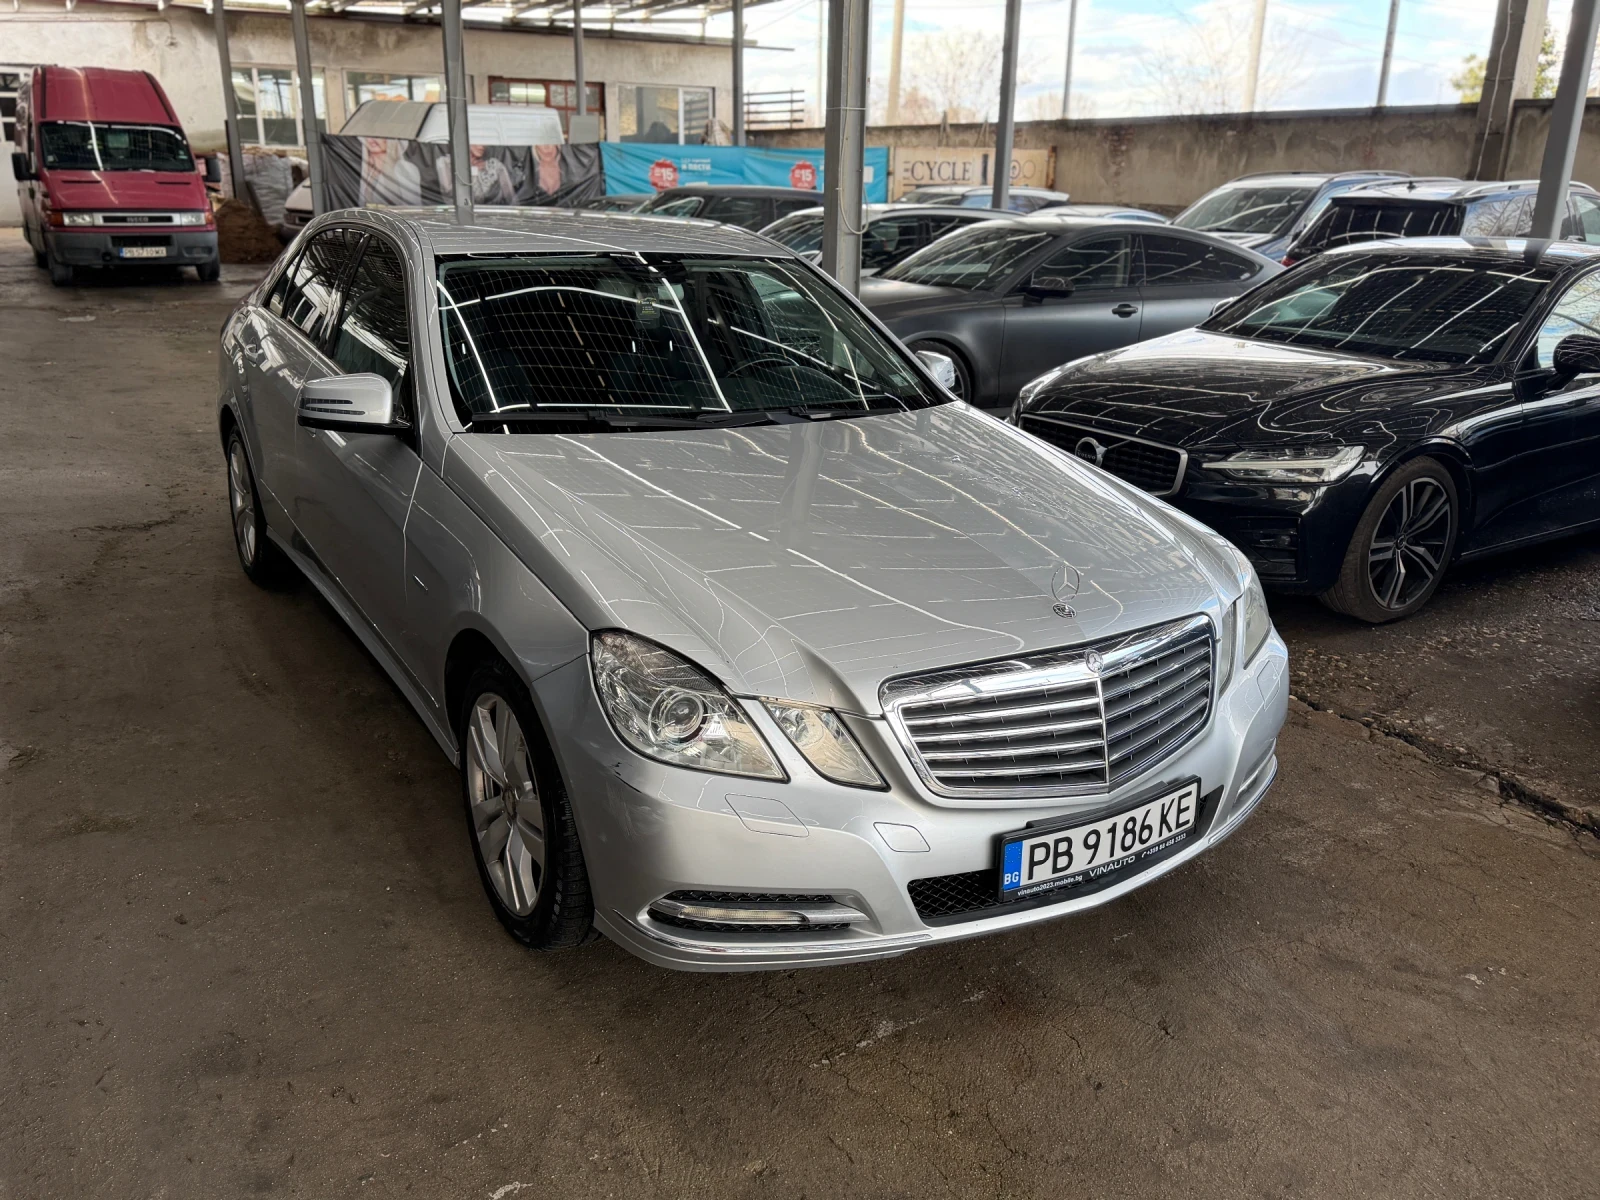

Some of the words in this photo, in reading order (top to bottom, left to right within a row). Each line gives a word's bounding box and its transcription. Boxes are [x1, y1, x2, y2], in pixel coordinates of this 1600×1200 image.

[1027, 836, 1074, 880] PB
[1083, 808, 1153, 865] 9186
[1158, 790, 1193, 838] KE
[1004, 871, 1019, 885] BG
[1017, 874, 1083, 896] vinauto2023.mobile.bg
[1089, 855, 1136, 877] VINAUTO
